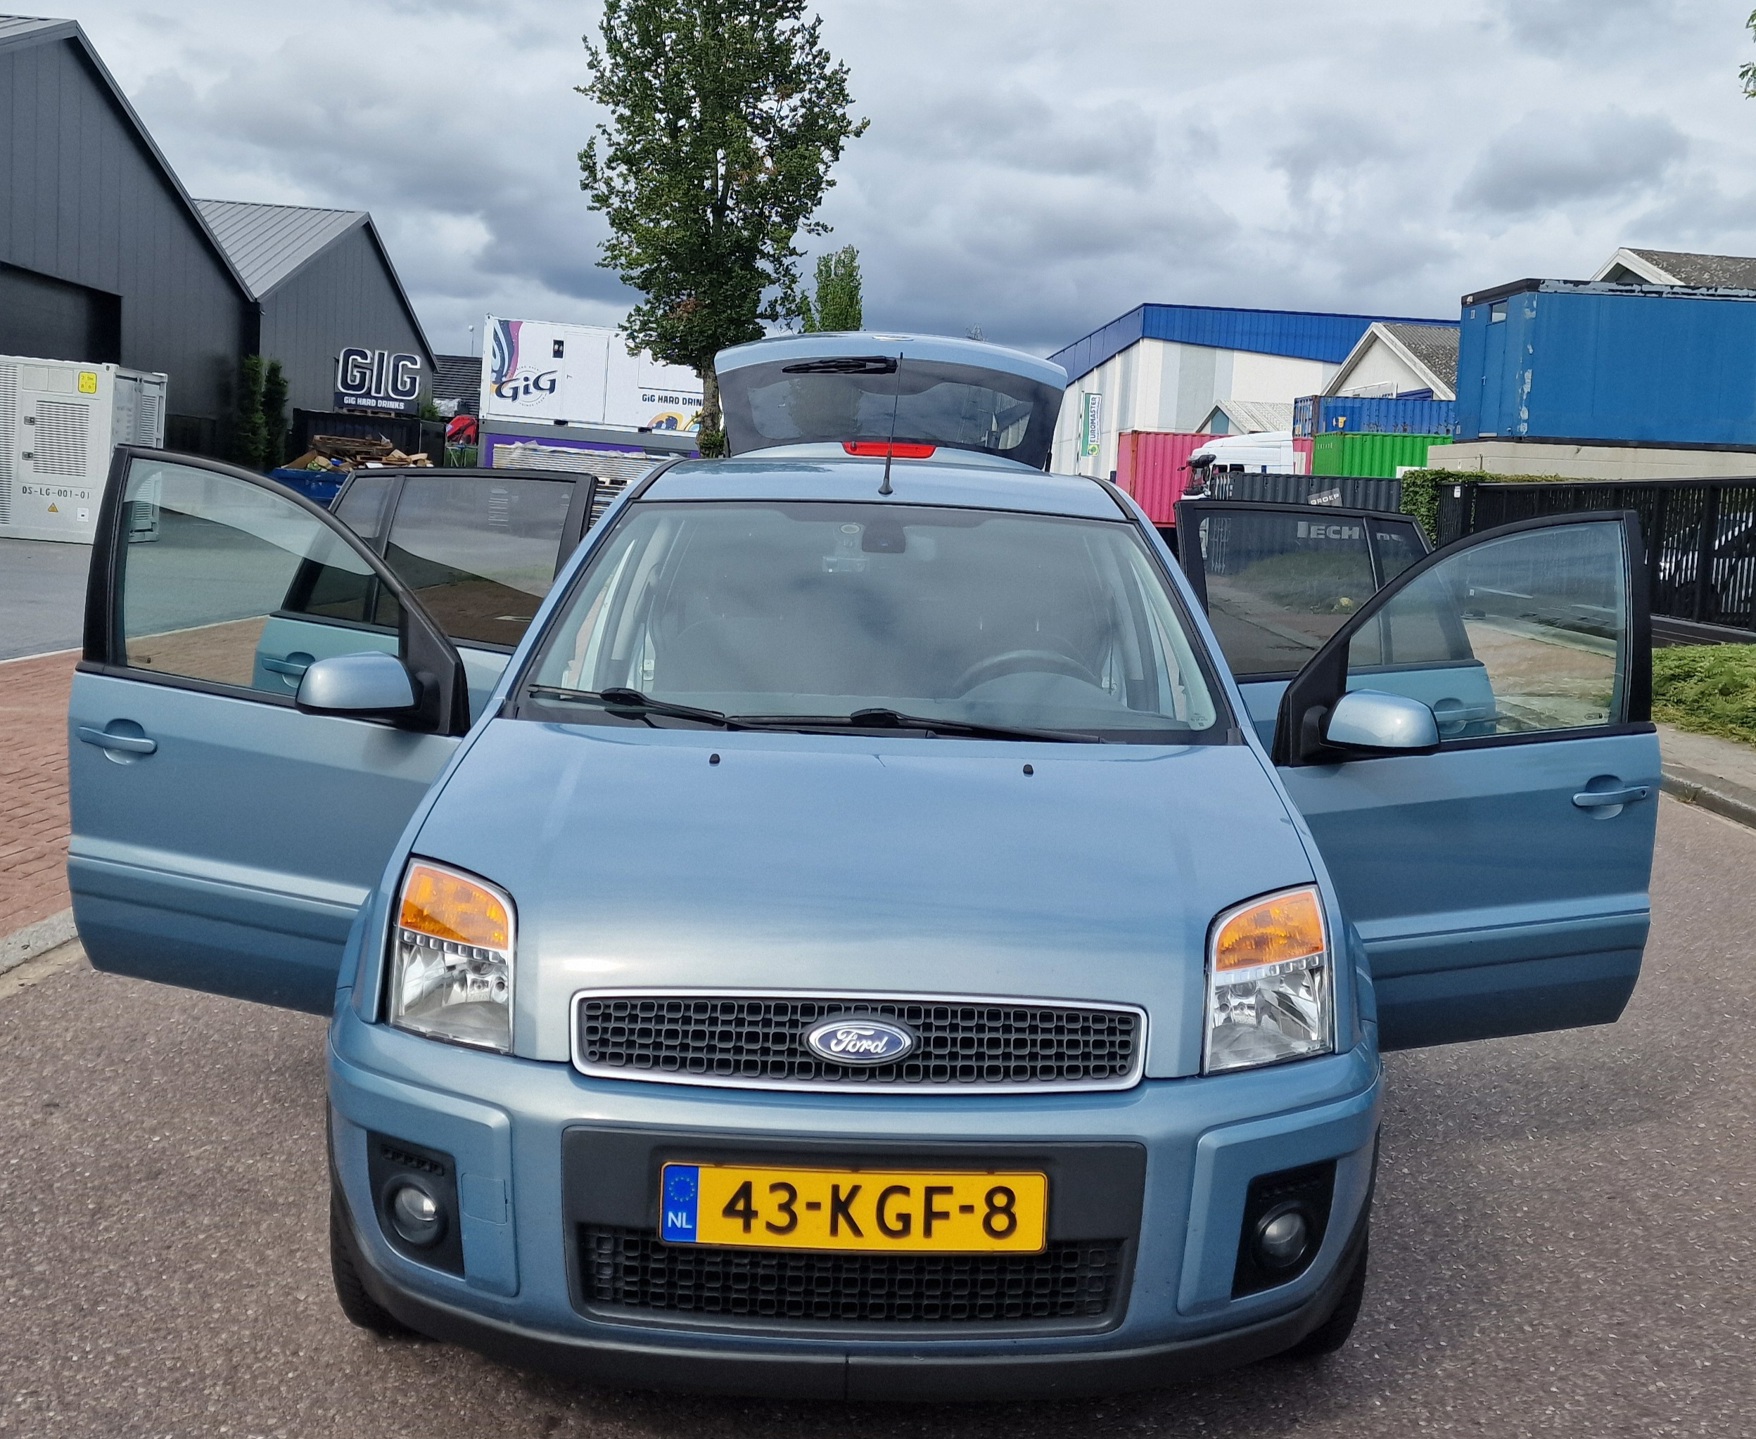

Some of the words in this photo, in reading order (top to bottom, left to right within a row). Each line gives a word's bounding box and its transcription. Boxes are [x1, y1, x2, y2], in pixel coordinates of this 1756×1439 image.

[337, 347, 421, 400] GIG
[495, 370, 558, 402] GiG
[357, 398, 376, 407] HARD
[377, 400, 404, 409] DRINKS
[641, 393, 656, 402] GiG
[657, 394, 680, 405] HARD
[682, 397, 704, 407] DRIN
[22, 485, 90, 499] DS-LG-001-01
[830, 1028, 889, 1054] Ford
[668, 1212, 692, 1229] NL
[721, 1180, 1018, 1240] 43-KGF-8
